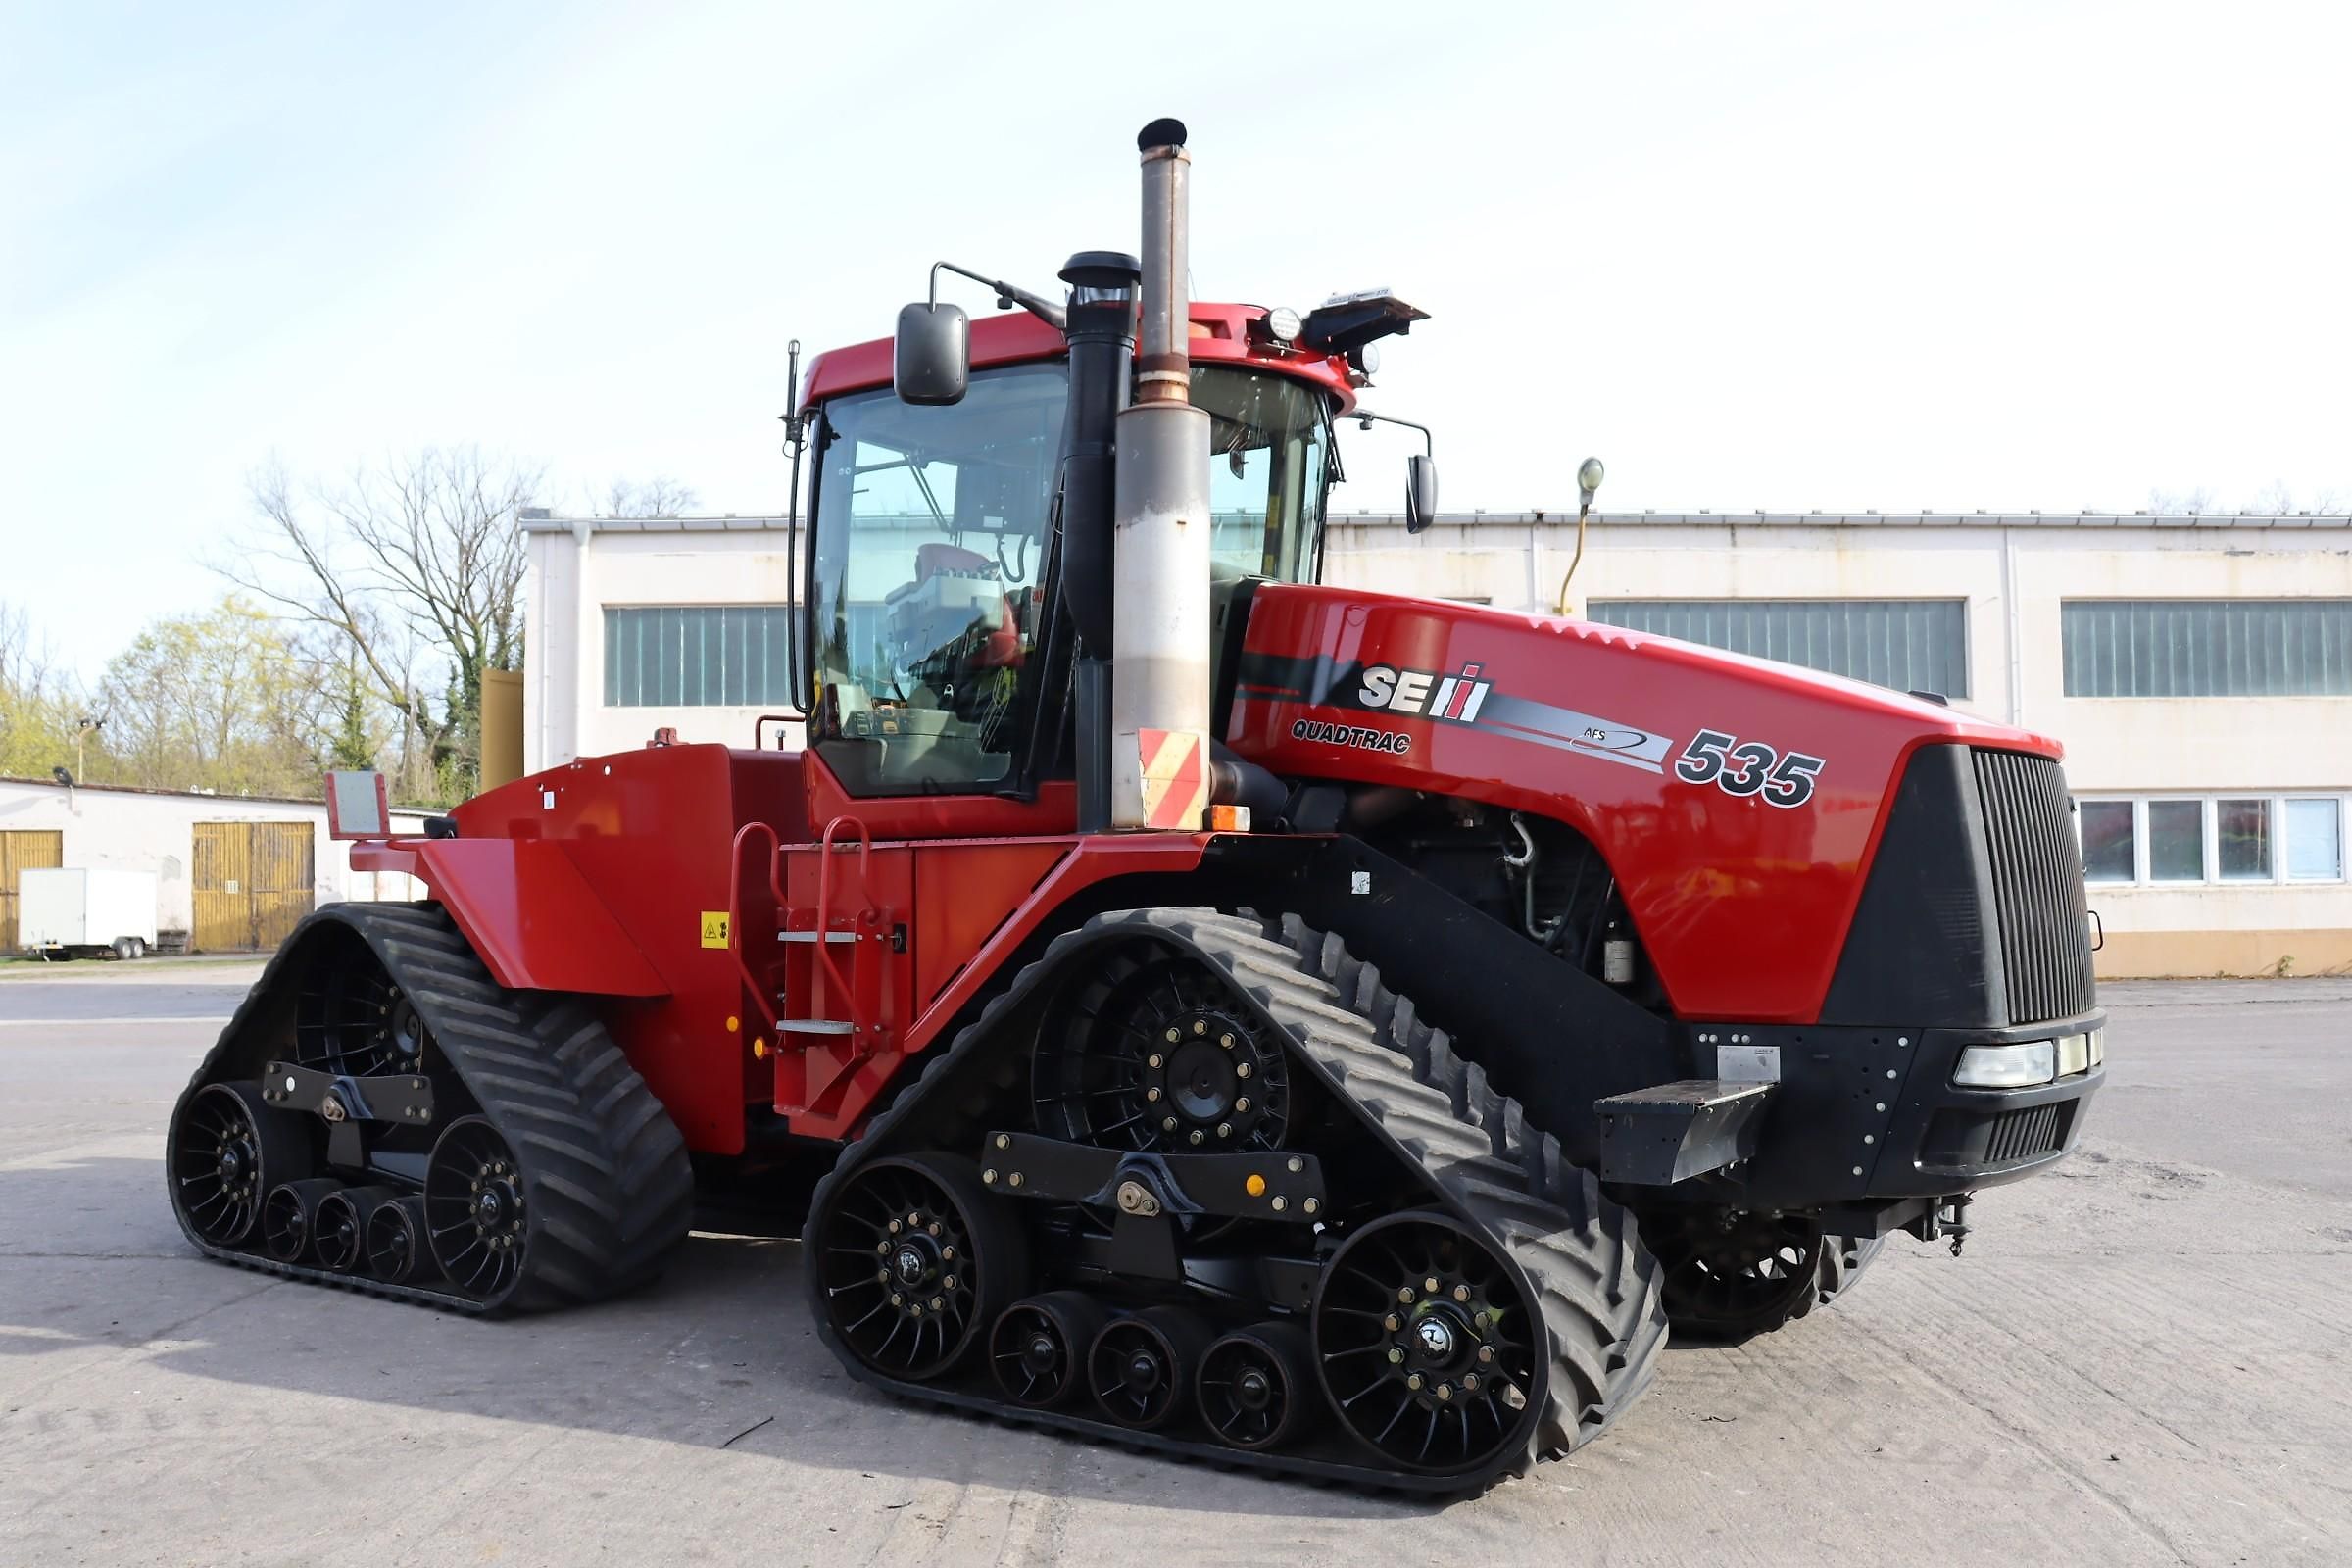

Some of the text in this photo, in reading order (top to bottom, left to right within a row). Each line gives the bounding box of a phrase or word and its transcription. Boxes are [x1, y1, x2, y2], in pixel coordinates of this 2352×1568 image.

[1292, 719, 1411, 755] QUADTRAC
[1584, 727, 1606, 741] AFS
[1674, 728, 1827, 808] 535
